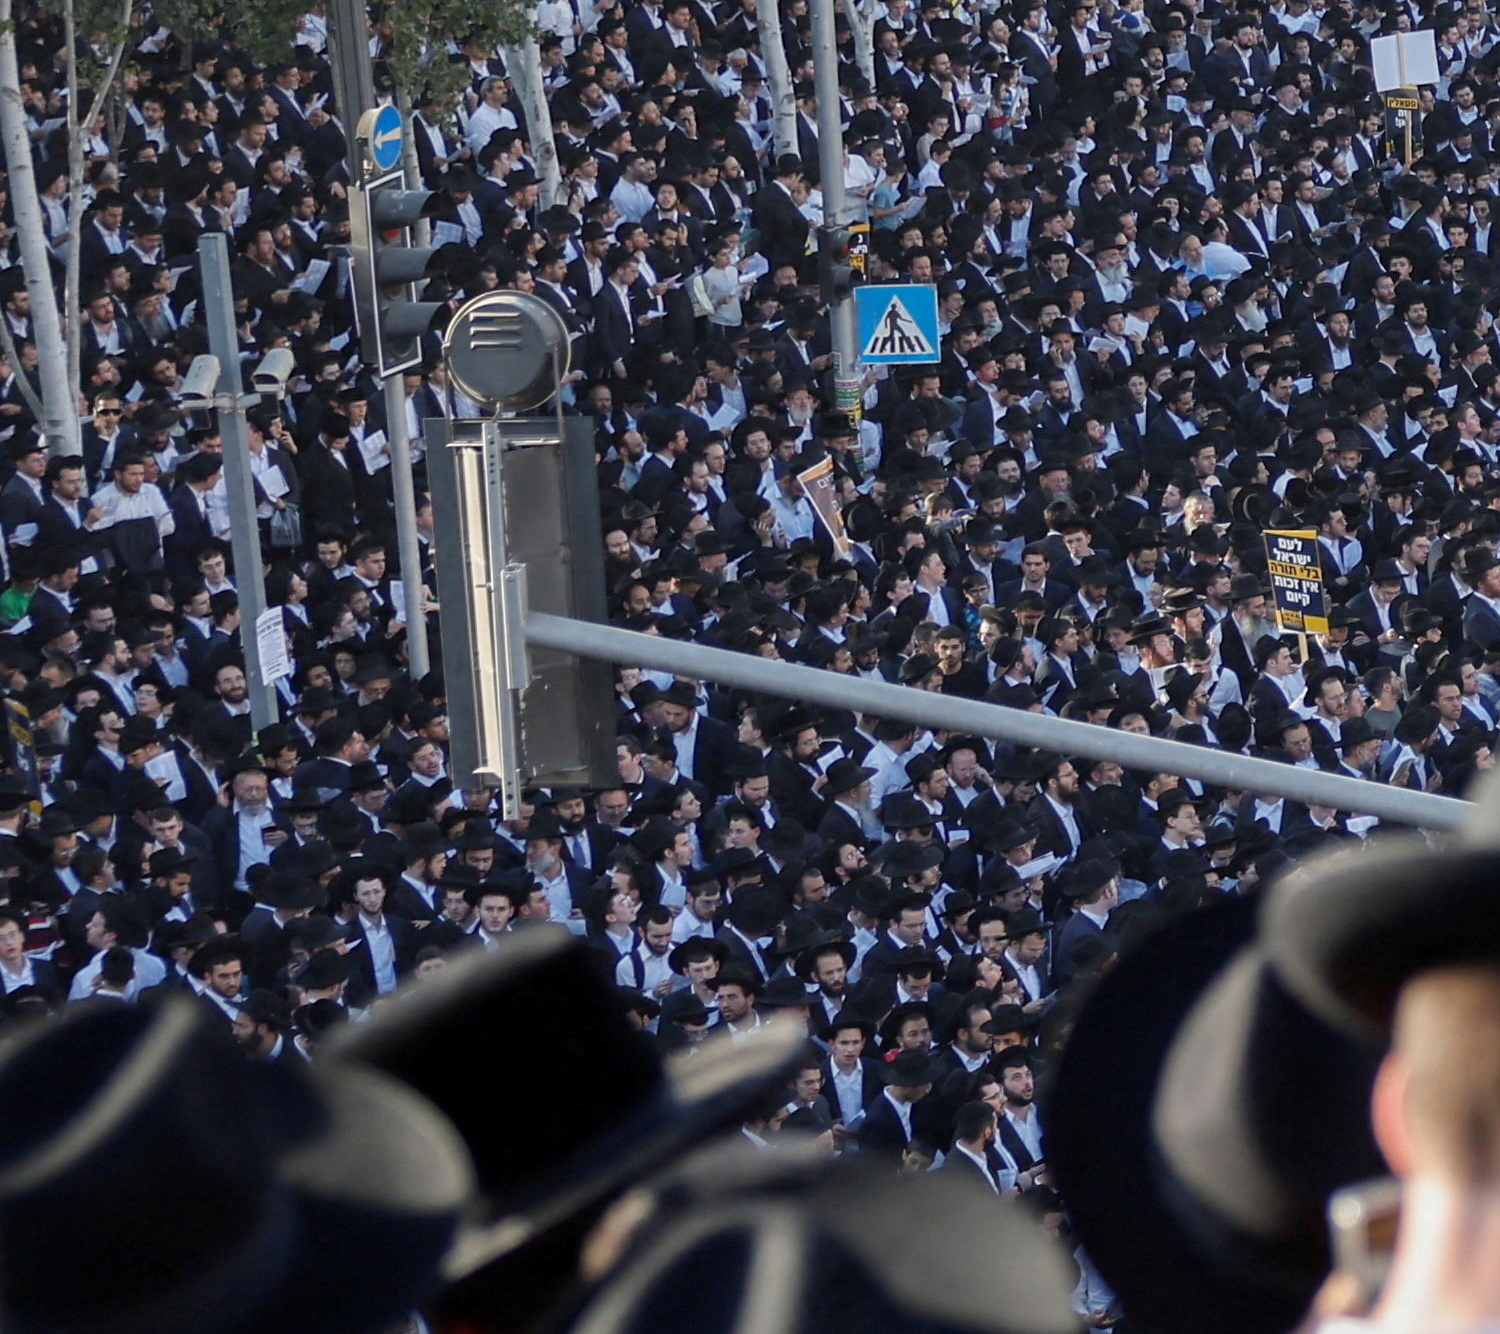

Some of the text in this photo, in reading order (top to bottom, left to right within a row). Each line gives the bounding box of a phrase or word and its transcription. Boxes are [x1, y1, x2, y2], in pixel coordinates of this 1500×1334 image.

[1277, 536, 1302, 552] לעם
[1273, 548, 1312, 566] ישראל
[1270, 562, 1320, 580] בלי תורה
[1274, 575, 1319, 595] אין זכות
[1285, 591, 1310, 608] קיום
